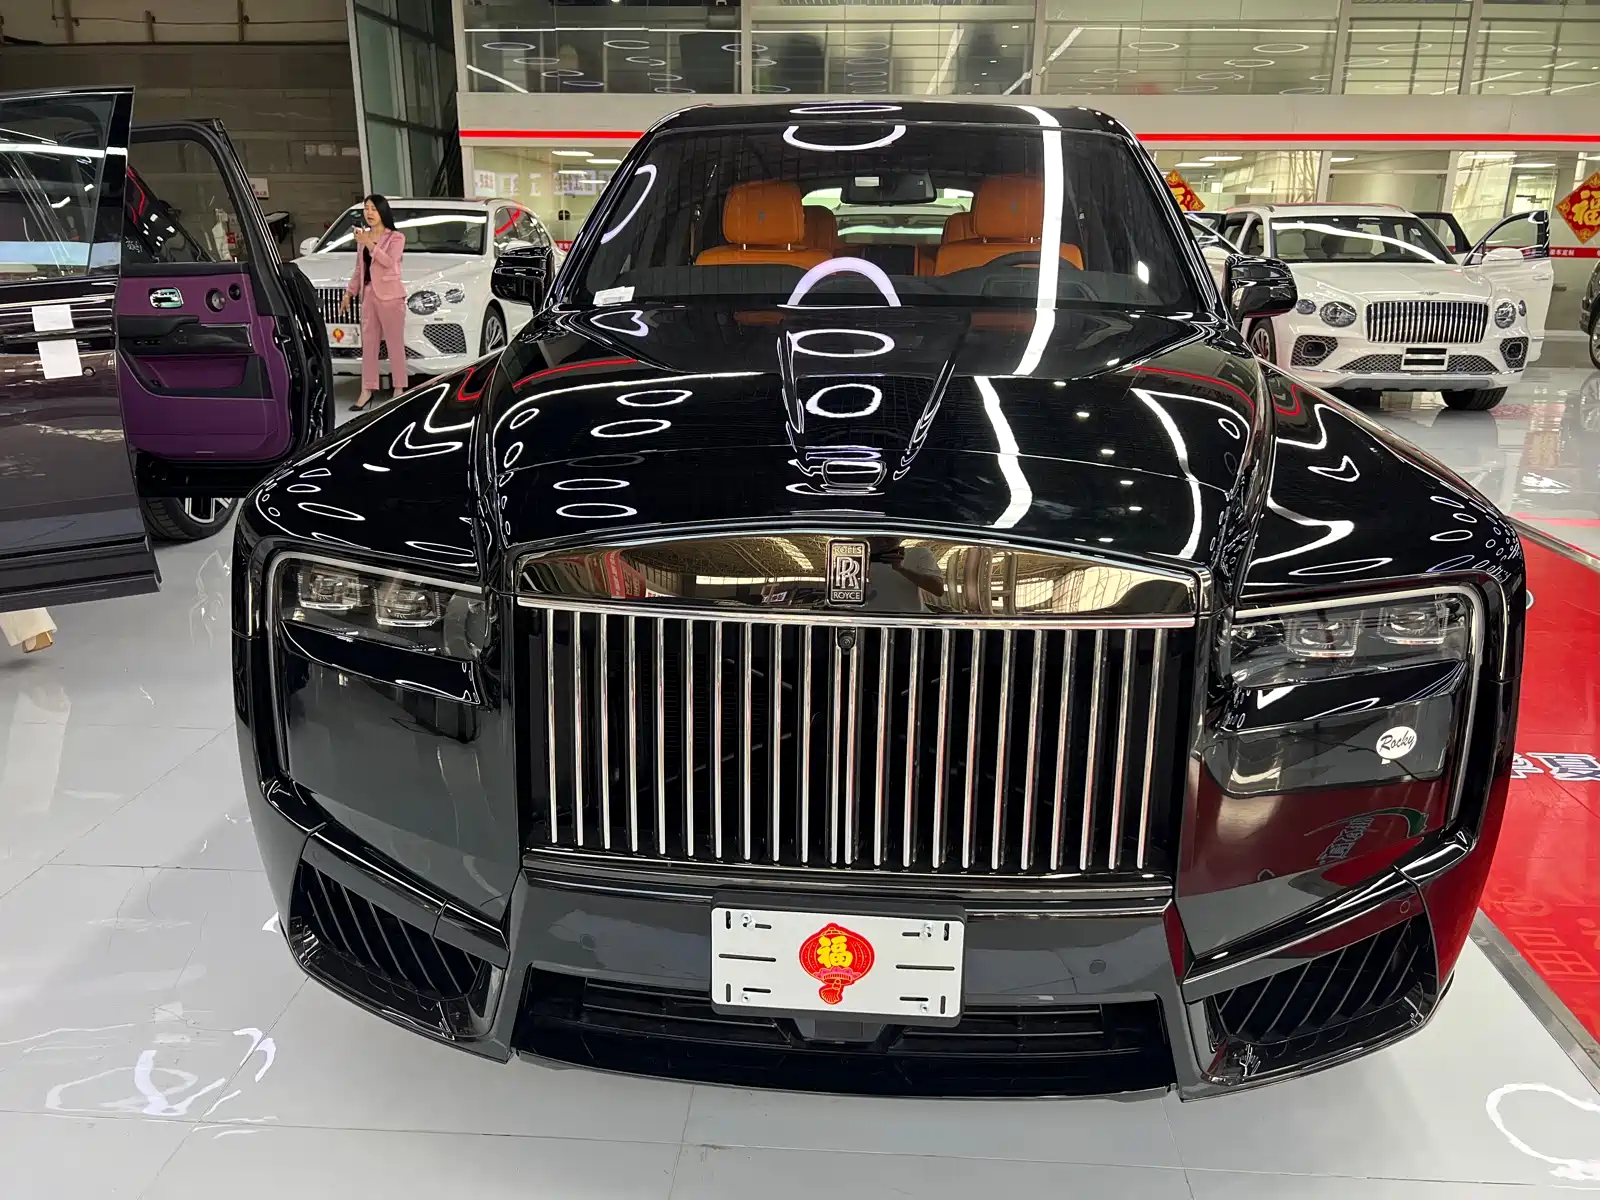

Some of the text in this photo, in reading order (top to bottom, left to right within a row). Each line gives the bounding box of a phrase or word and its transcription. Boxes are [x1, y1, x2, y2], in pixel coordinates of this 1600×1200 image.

[834, 546, 861, 554] ROLLS
[1379, 730, 1415, 752] Rocky
[816, 935, 853, 968] 福
